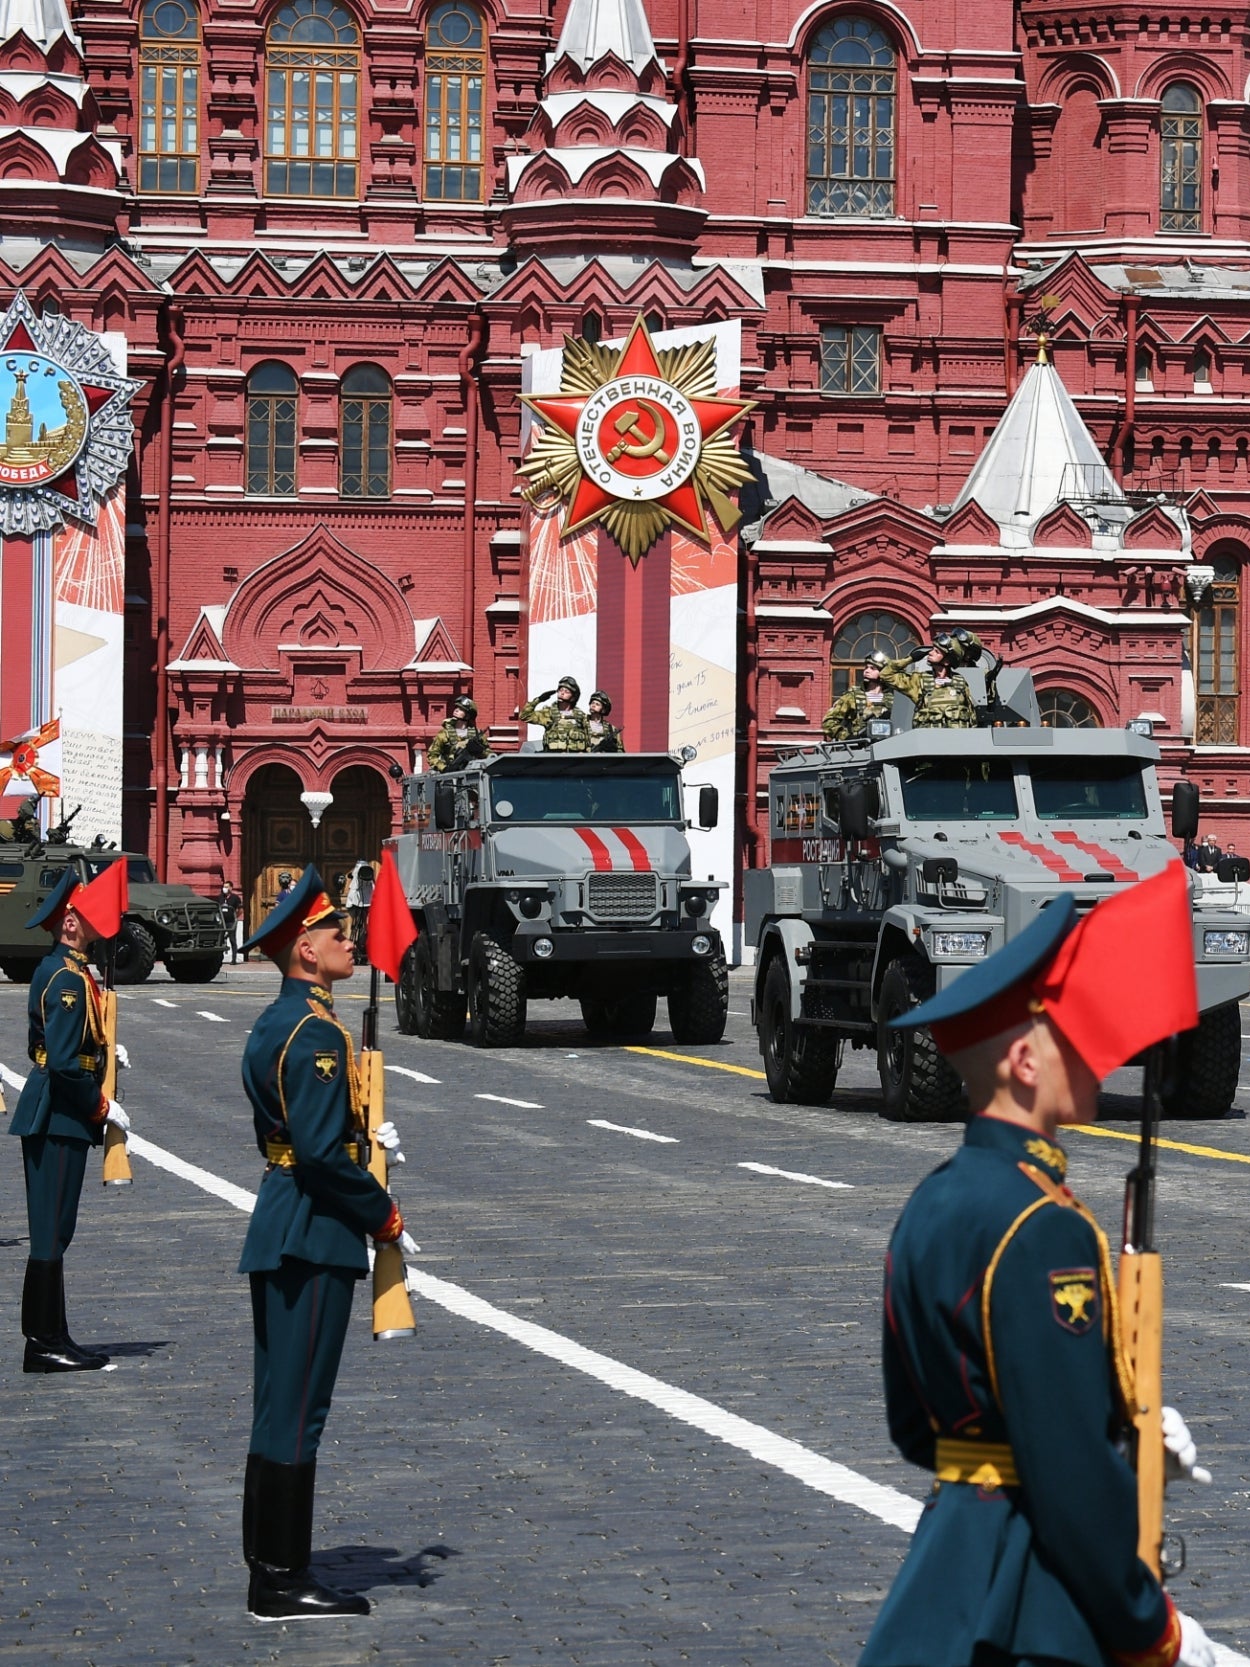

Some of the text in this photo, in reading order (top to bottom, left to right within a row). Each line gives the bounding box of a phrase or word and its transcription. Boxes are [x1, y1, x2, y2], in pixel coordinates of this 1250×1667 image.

[582, 381, 696, 488] ОТЕЧЕСТВЕННАЯ ВОЙНА
[0, 464, 48, 479] ОБЕДА
